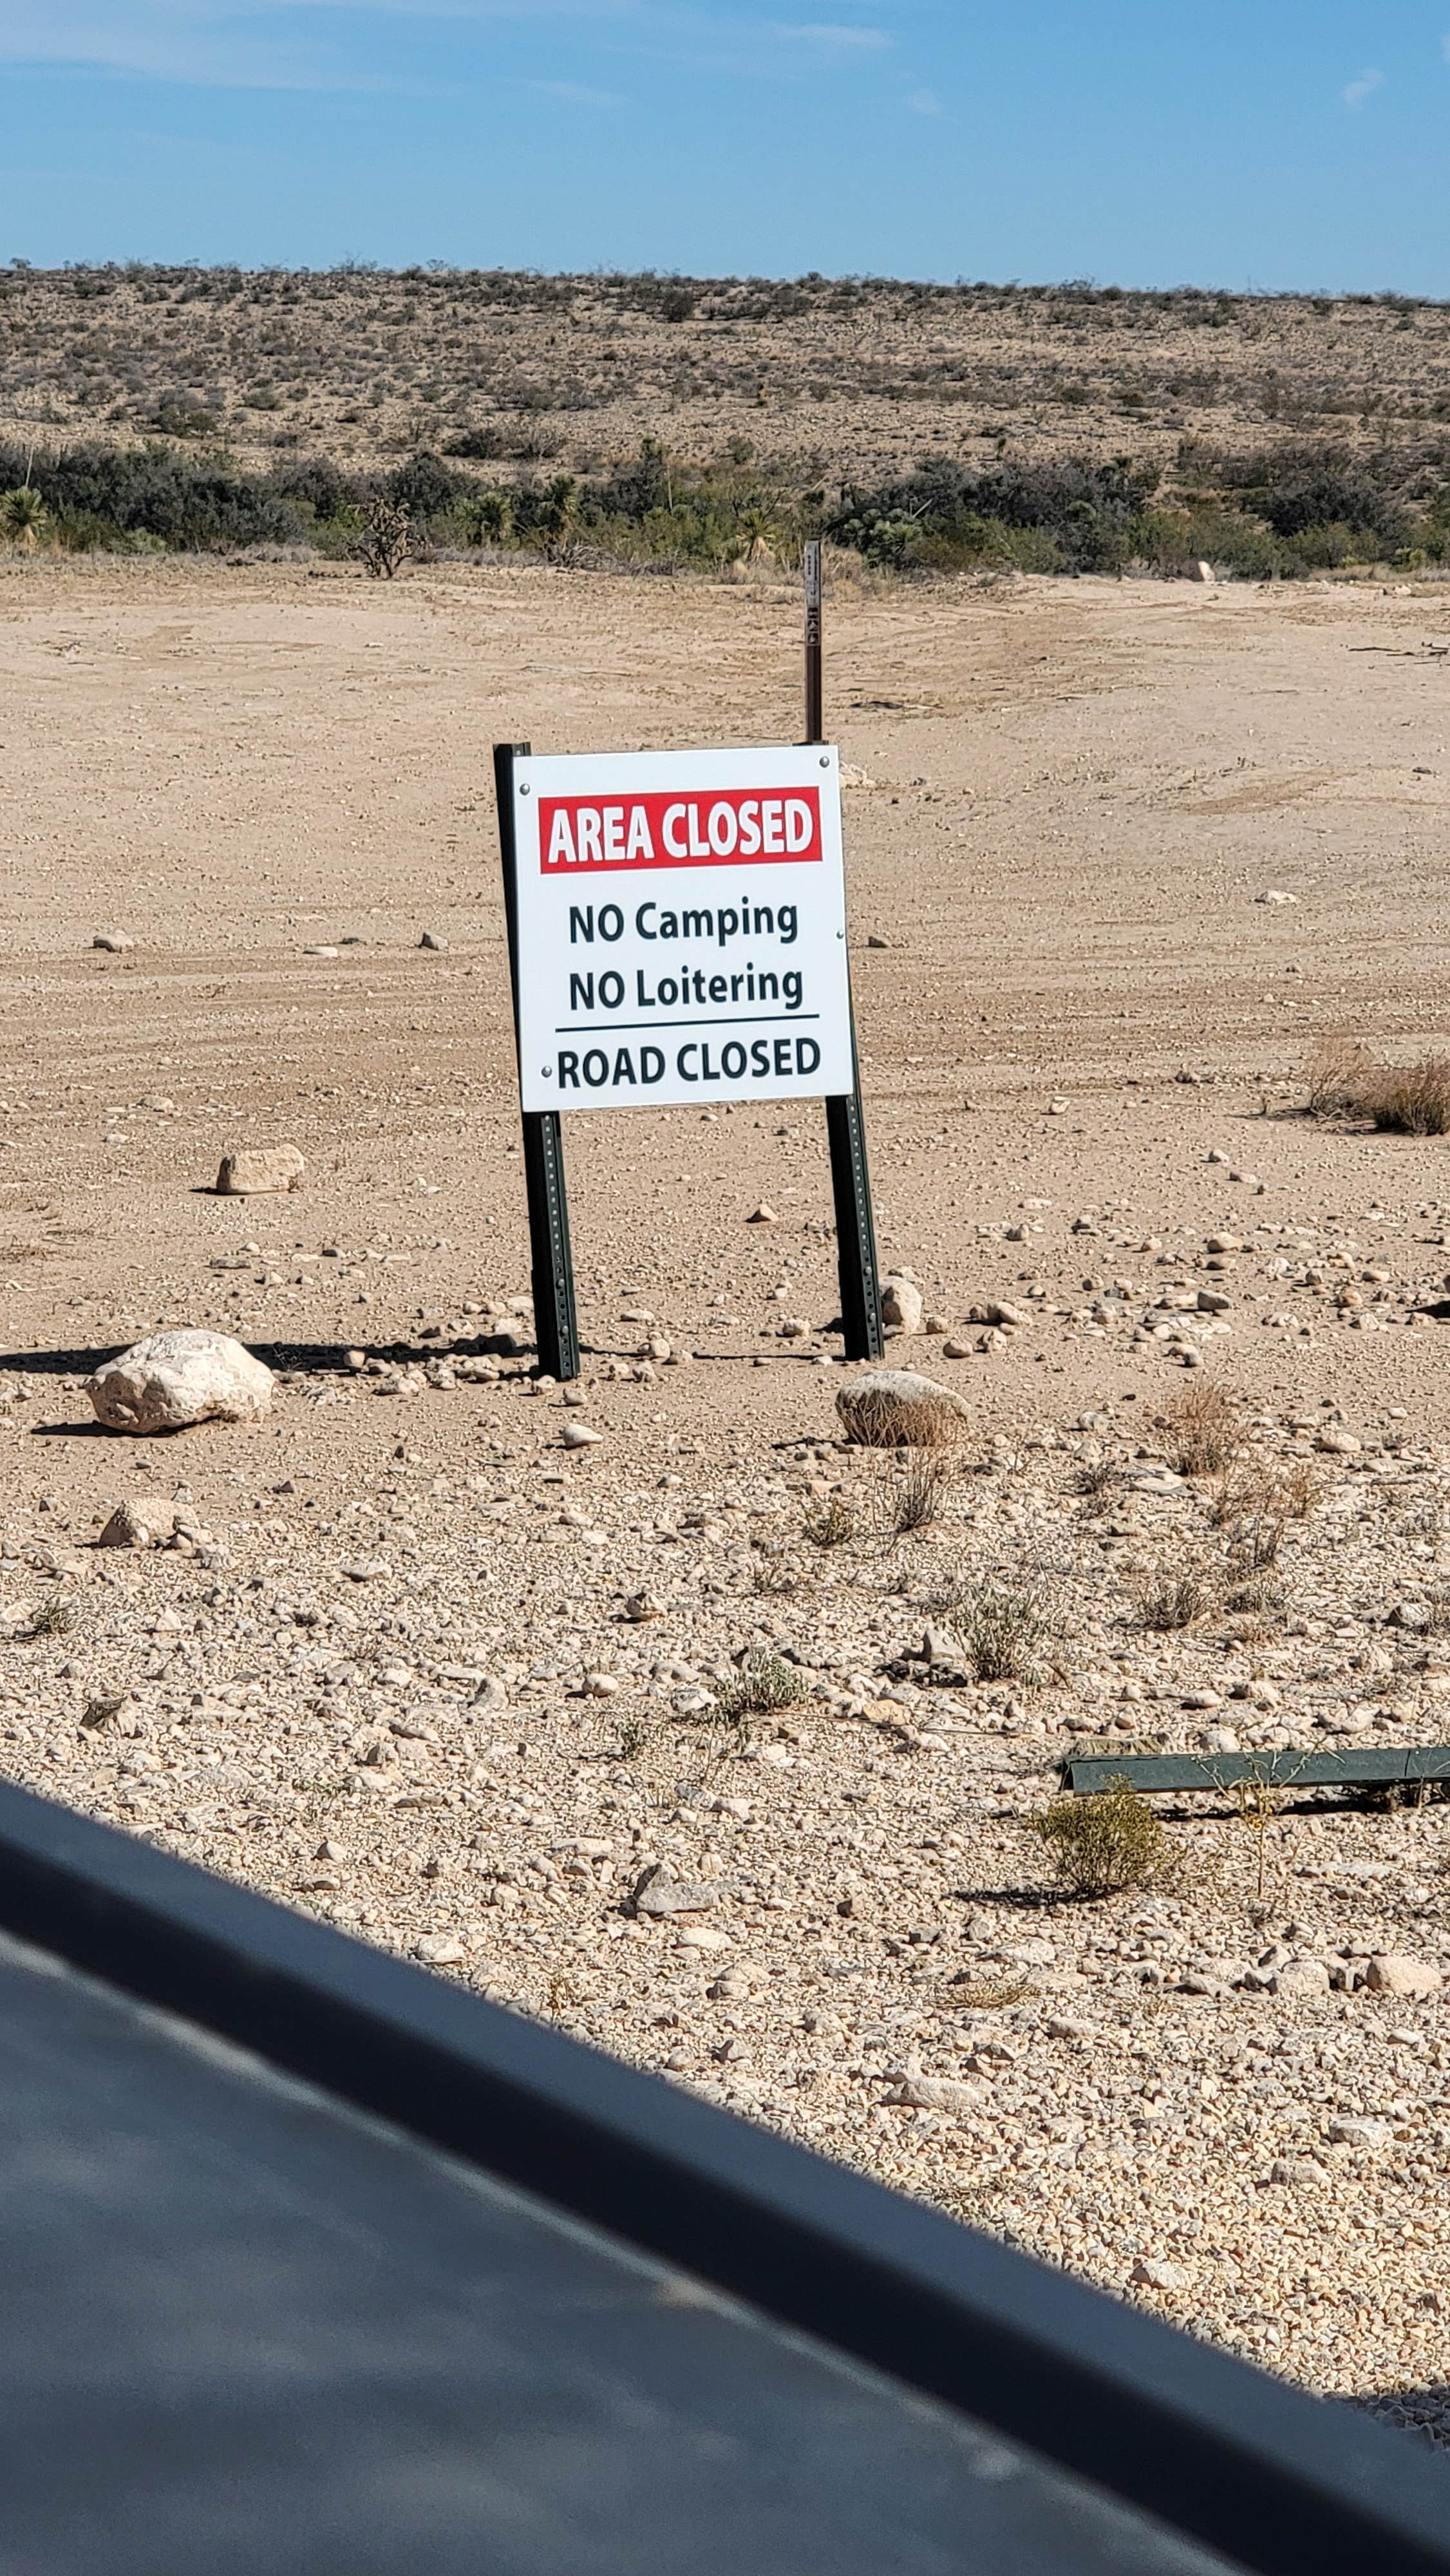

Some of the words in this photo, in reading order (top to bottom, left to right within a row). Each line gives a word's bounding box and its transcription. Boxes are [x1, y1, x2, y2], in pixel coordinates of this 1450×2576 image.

[548, 806, 655, 864] AREA
[662, 799, 813, 858] CLOSED
[569, 904, 625, 943] NO
[636, 896, 798, 947] Camping
[570, 971, 625, 1010] NO
[637, 961, 803, 1010] Loitering
[558, 1046, 666, 1089] ROAD
[677, 1037, 821, 1082] CLOSED
